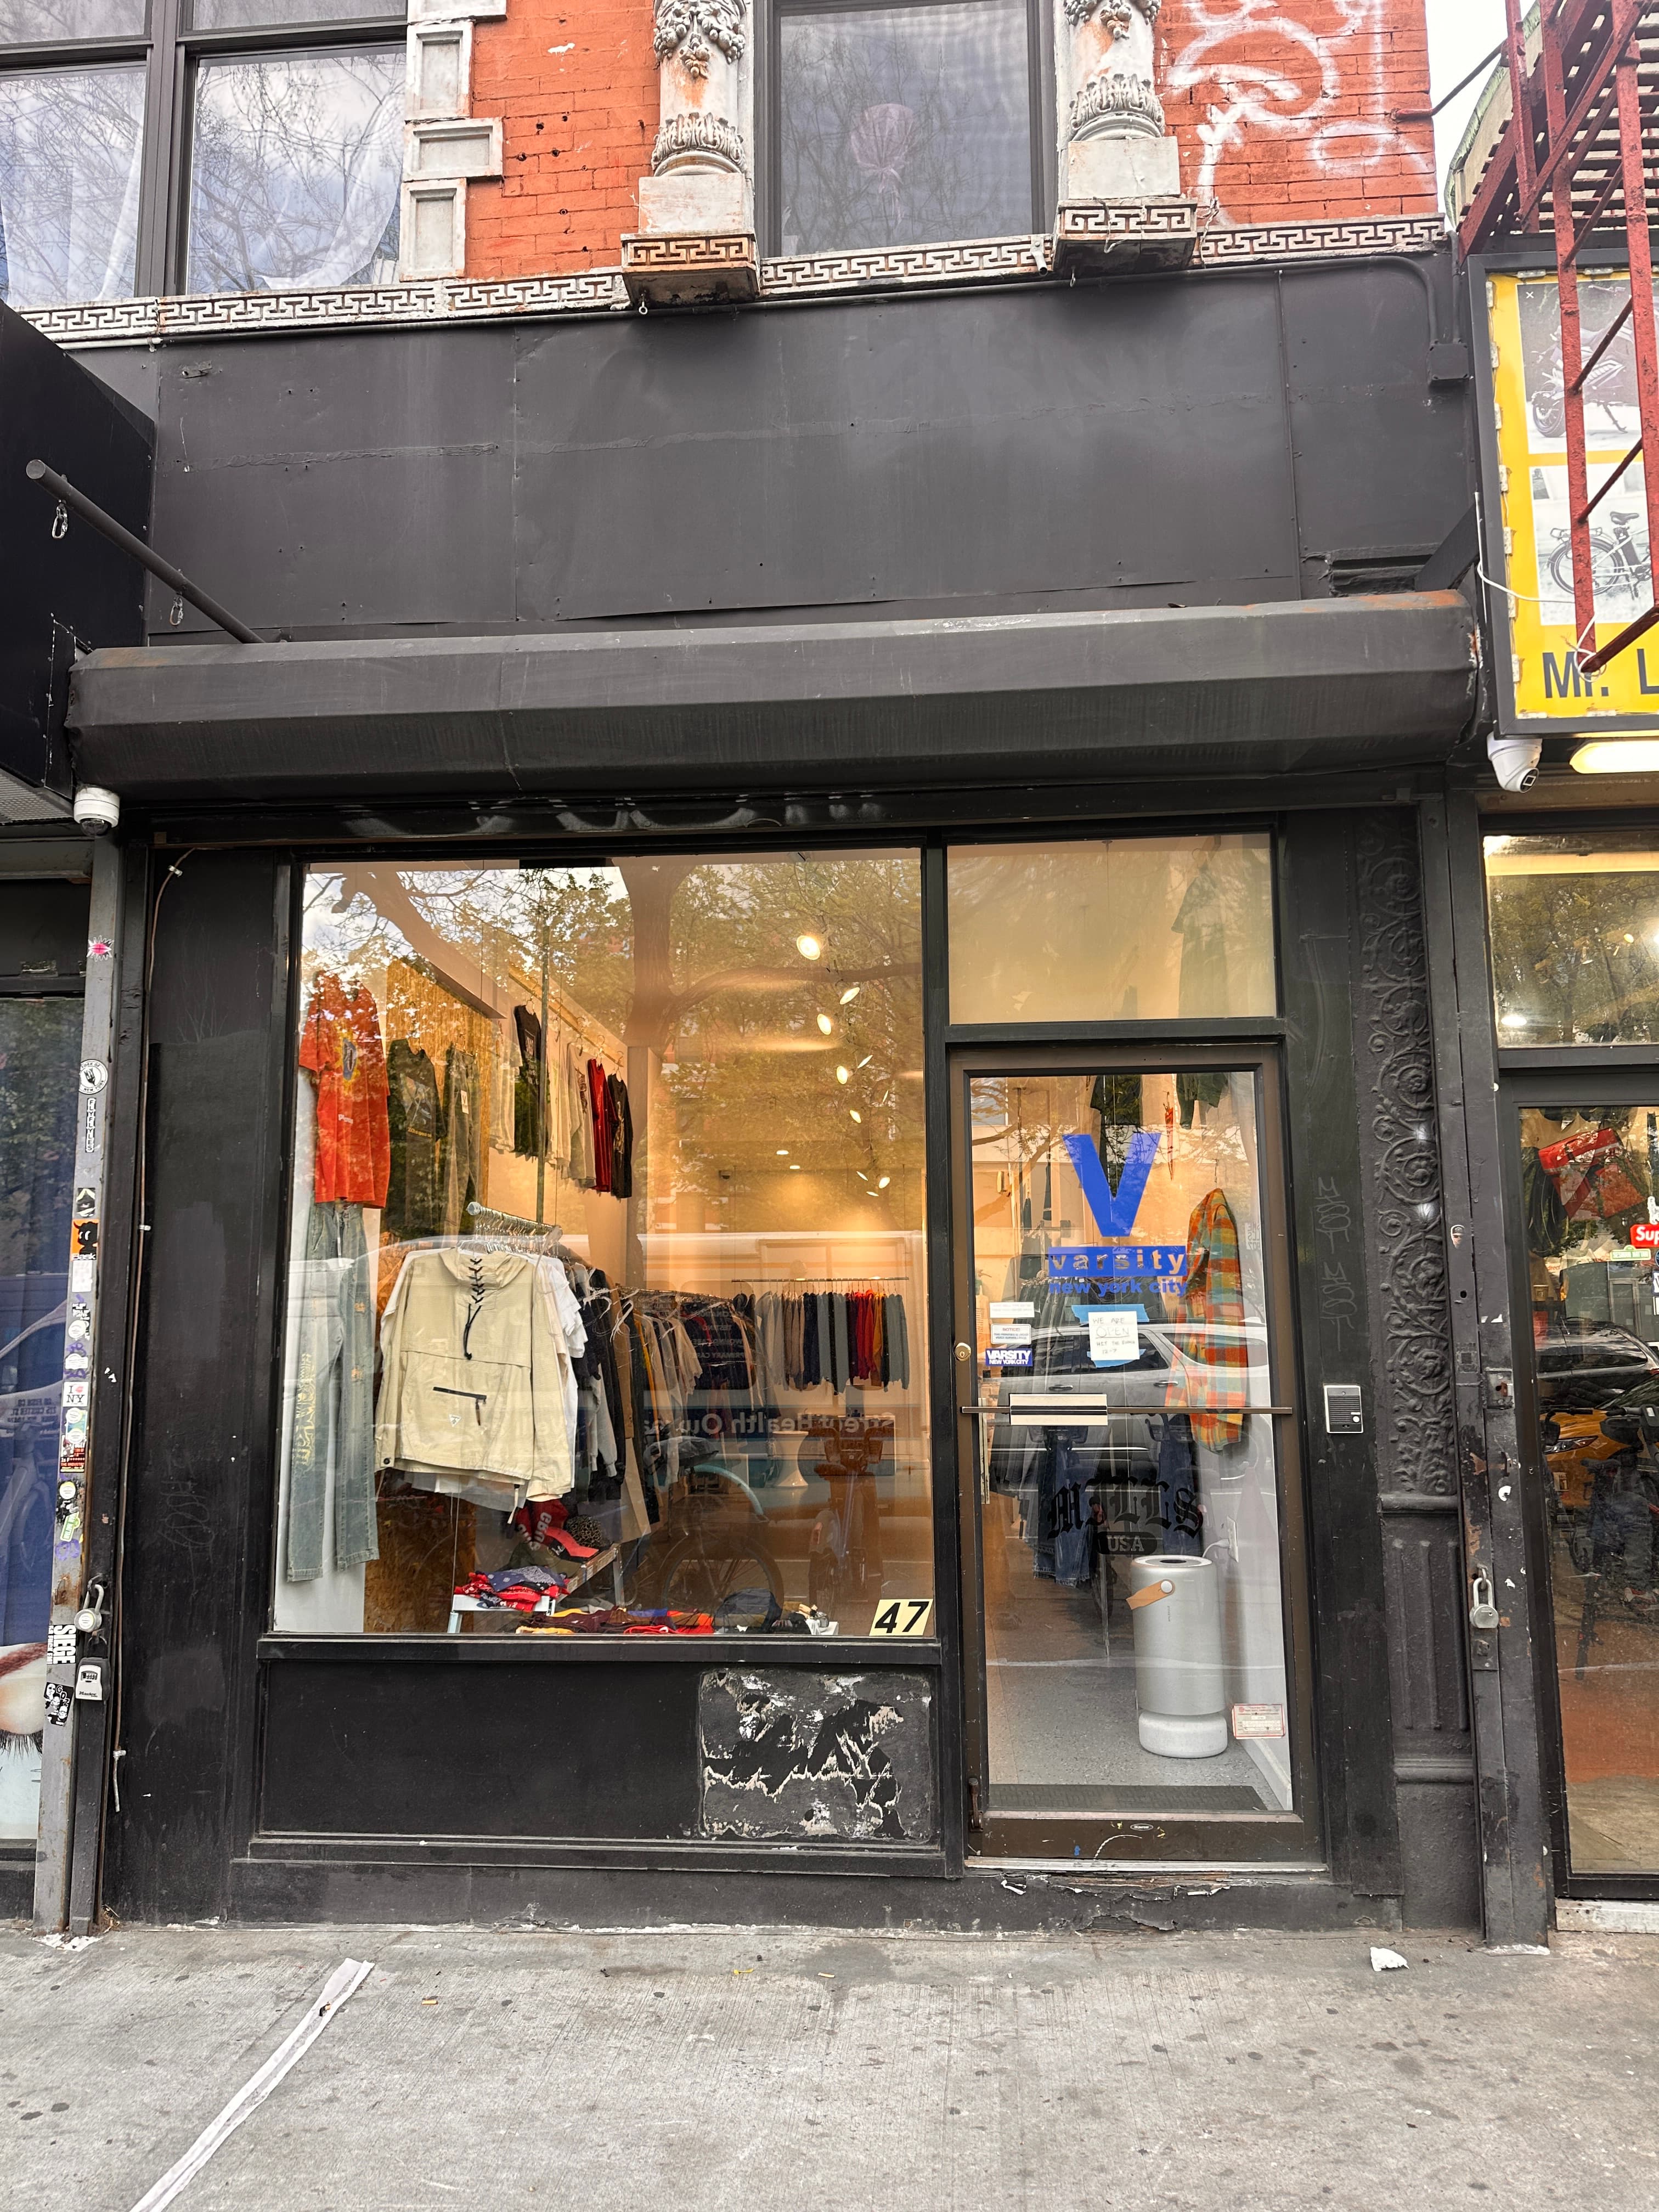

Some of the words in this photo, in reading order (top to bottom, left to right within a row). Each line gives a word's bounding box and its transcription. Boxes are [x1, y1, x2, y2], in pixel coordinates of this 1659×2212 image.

[1063, 1133, 1161, 1238] V
[1051, 1249, 1185, 1275] varsity
[1049, 1283, 1091, 1294] new
[1097, 1279, 1143, 1297] york
[1149, 1278, 1188, 1297] city
[1096, 1326, 1129, 1338] OPEN
[986, 1350, 1031, 1359] VARSITY
[66, 1395, 85, 1403] NY
[1107, 1535, 1145, 1552] USA
[874, 1601, 930, 1634] 47
[53, 1624, 76, 1664] SIEGE
